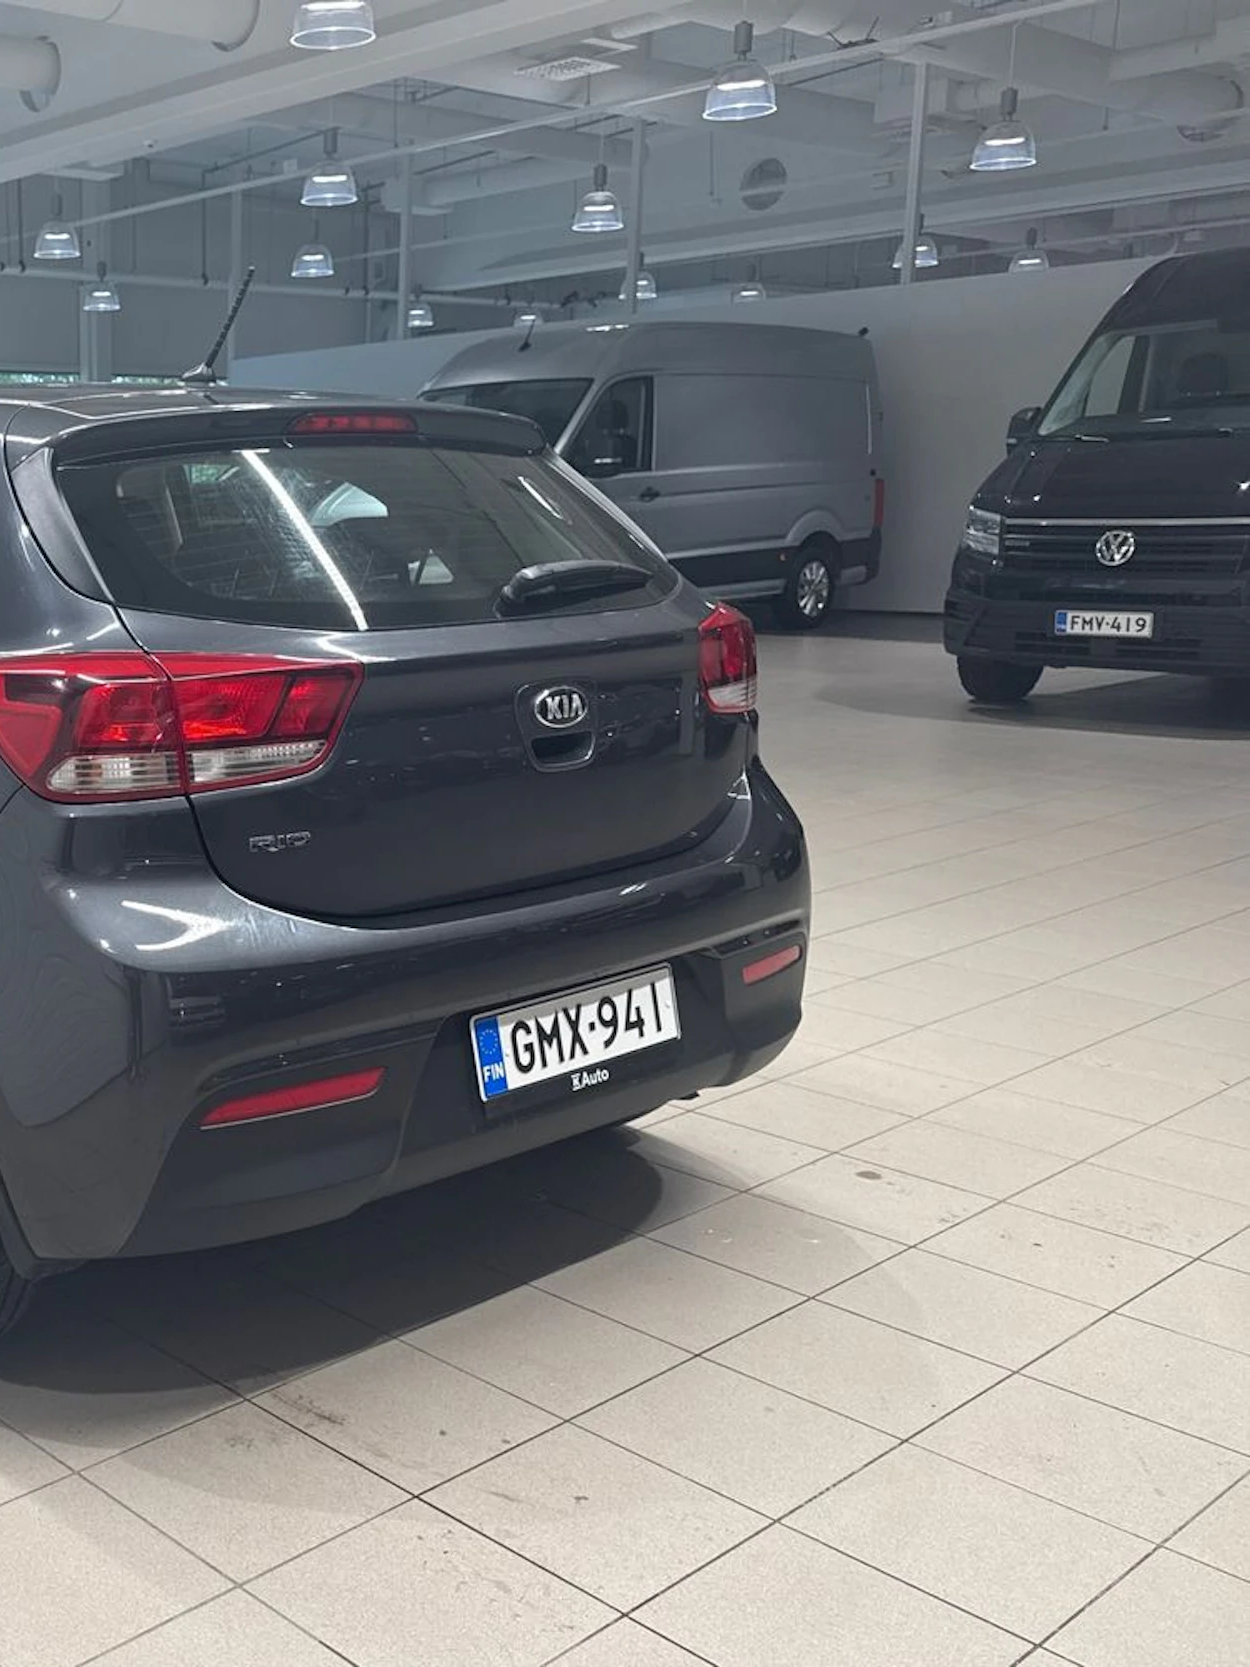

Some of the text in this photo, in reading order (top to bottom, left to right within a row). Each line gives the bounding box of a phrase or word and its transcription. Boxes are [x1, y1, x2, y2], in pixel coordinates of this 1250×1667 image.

[1070, 615, 1147, 633] FMV-419
[546, 693, 583, 720] KIA
[249, 831, 311, 853] RIO
[511, 983, 662, 1074] GMX-941
[483, 1061, 504, 1082] FIN
